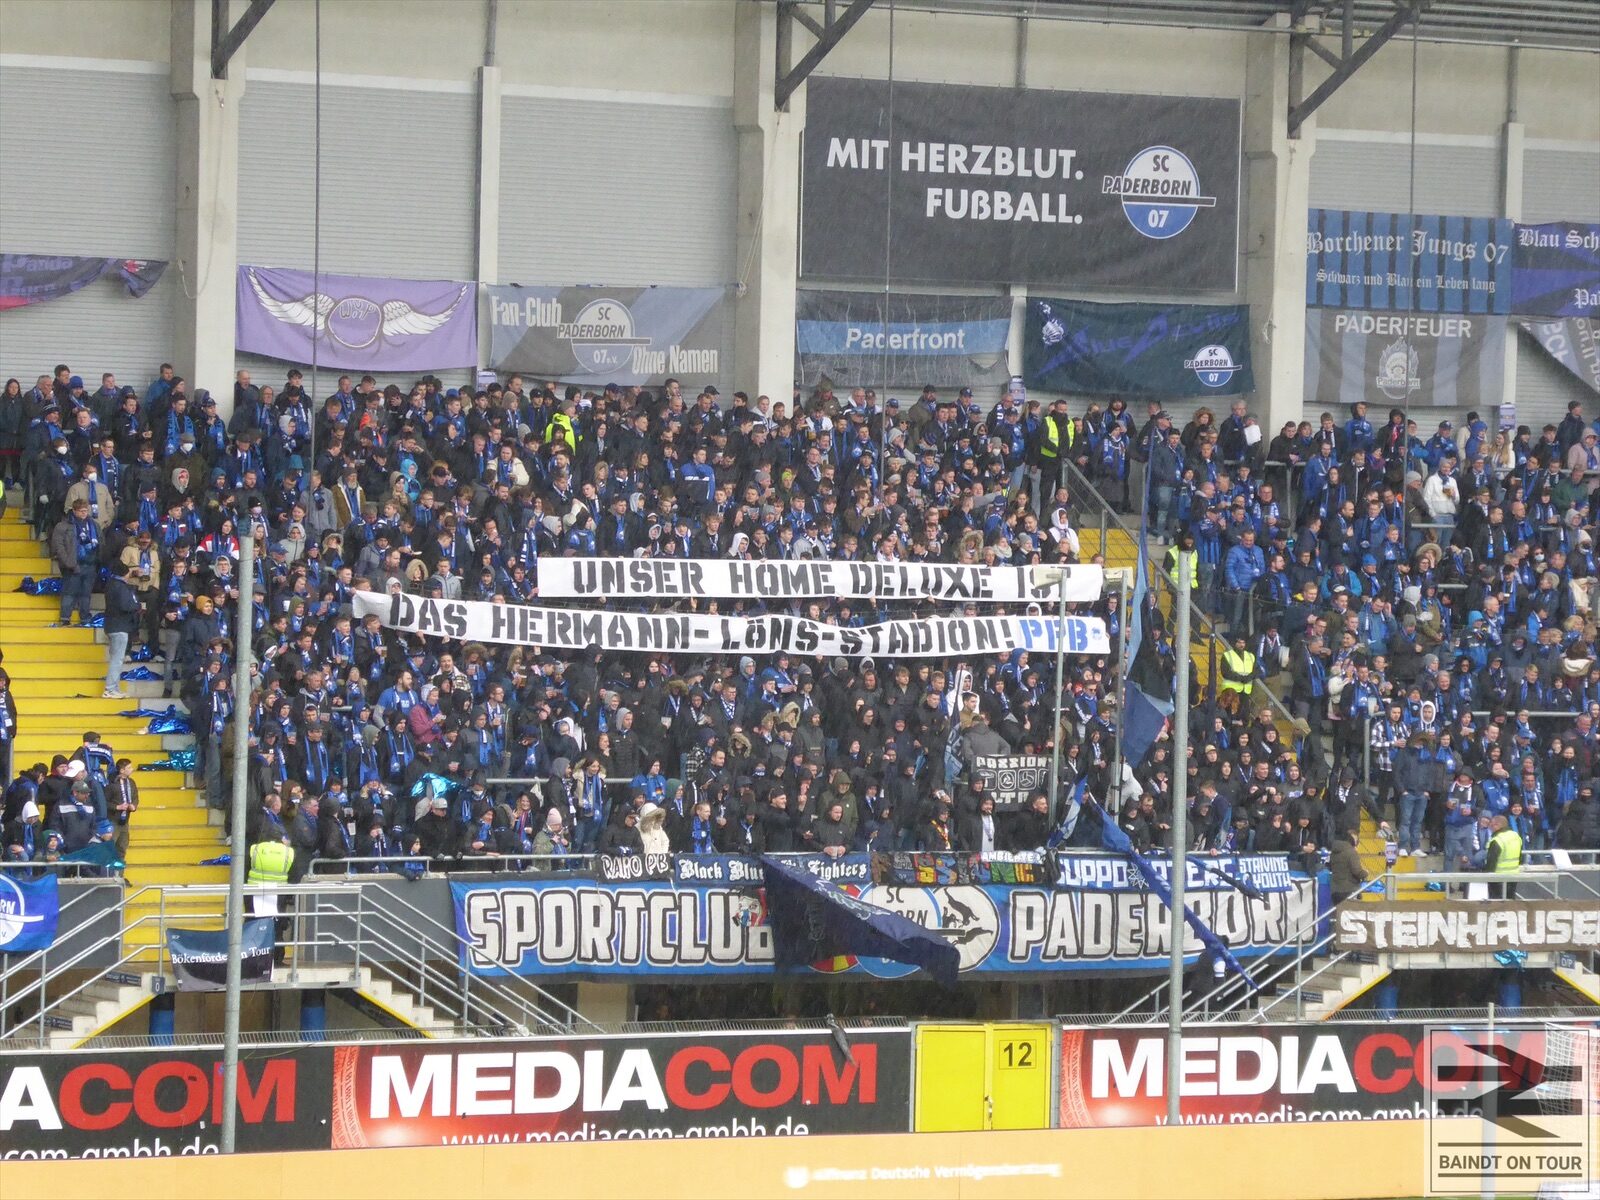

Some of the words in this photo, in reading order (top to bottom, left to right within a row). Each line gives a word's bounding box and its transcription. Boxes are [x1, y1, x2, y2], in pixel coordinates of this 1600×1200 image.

[826, 137, 889, 170] MIT
[901, 142, 1084, 181] HERZBLUT.
[1152, 153, 1170, 173] SC
[1102, 175, 1192, 197] PADERBORN
[1147, 209, 1169, 229] 07
[1306, 231, 1405, 256] Borchener
[1411, 230, 1477, 263] Jungs
[1483, 242, 1509, 265] 07
[1518, 228, 1560, 248] Blau
[1316, 268, 1361, 286] Schwarz
[1364, 272, 1382, 286] und
[1416, 276, 1432, 288] ein
[491, 295, 562, 327] Fan-Club
[597, 307, 611, 321] SC
[557, 324, 626, 339] PADERBORN
[1335, 315, 1472, 338] PADERFEUER
[845, 327, 966, 352] Paderfront
[593, 351, 607, 364] 07
[631, 346, 665, 375] Ohne
[669, 345, 718, 374] Namen
[1208, 348, 1219, 358] SC
[1184, 358, 1230, 369] PADERBORN
[1208, 373, 1220, 383] 07
[573, 561, 705, 594] UNSER
[731, 563, 836, 597] HOME
[851, 563, 993, 599] DELUXE
[390, 593, 468, 636] DAS
[679, 859, 723, 880] Black
[1239, 856, 1288, 873] STRIVING
[1252, 872, 1292, 888] YOUTH
[249, 945, 270, 957] Tour
[1003, 1042, 1033, 1067] 12
[370, 1043, 877, 1118] MEDIACOM
